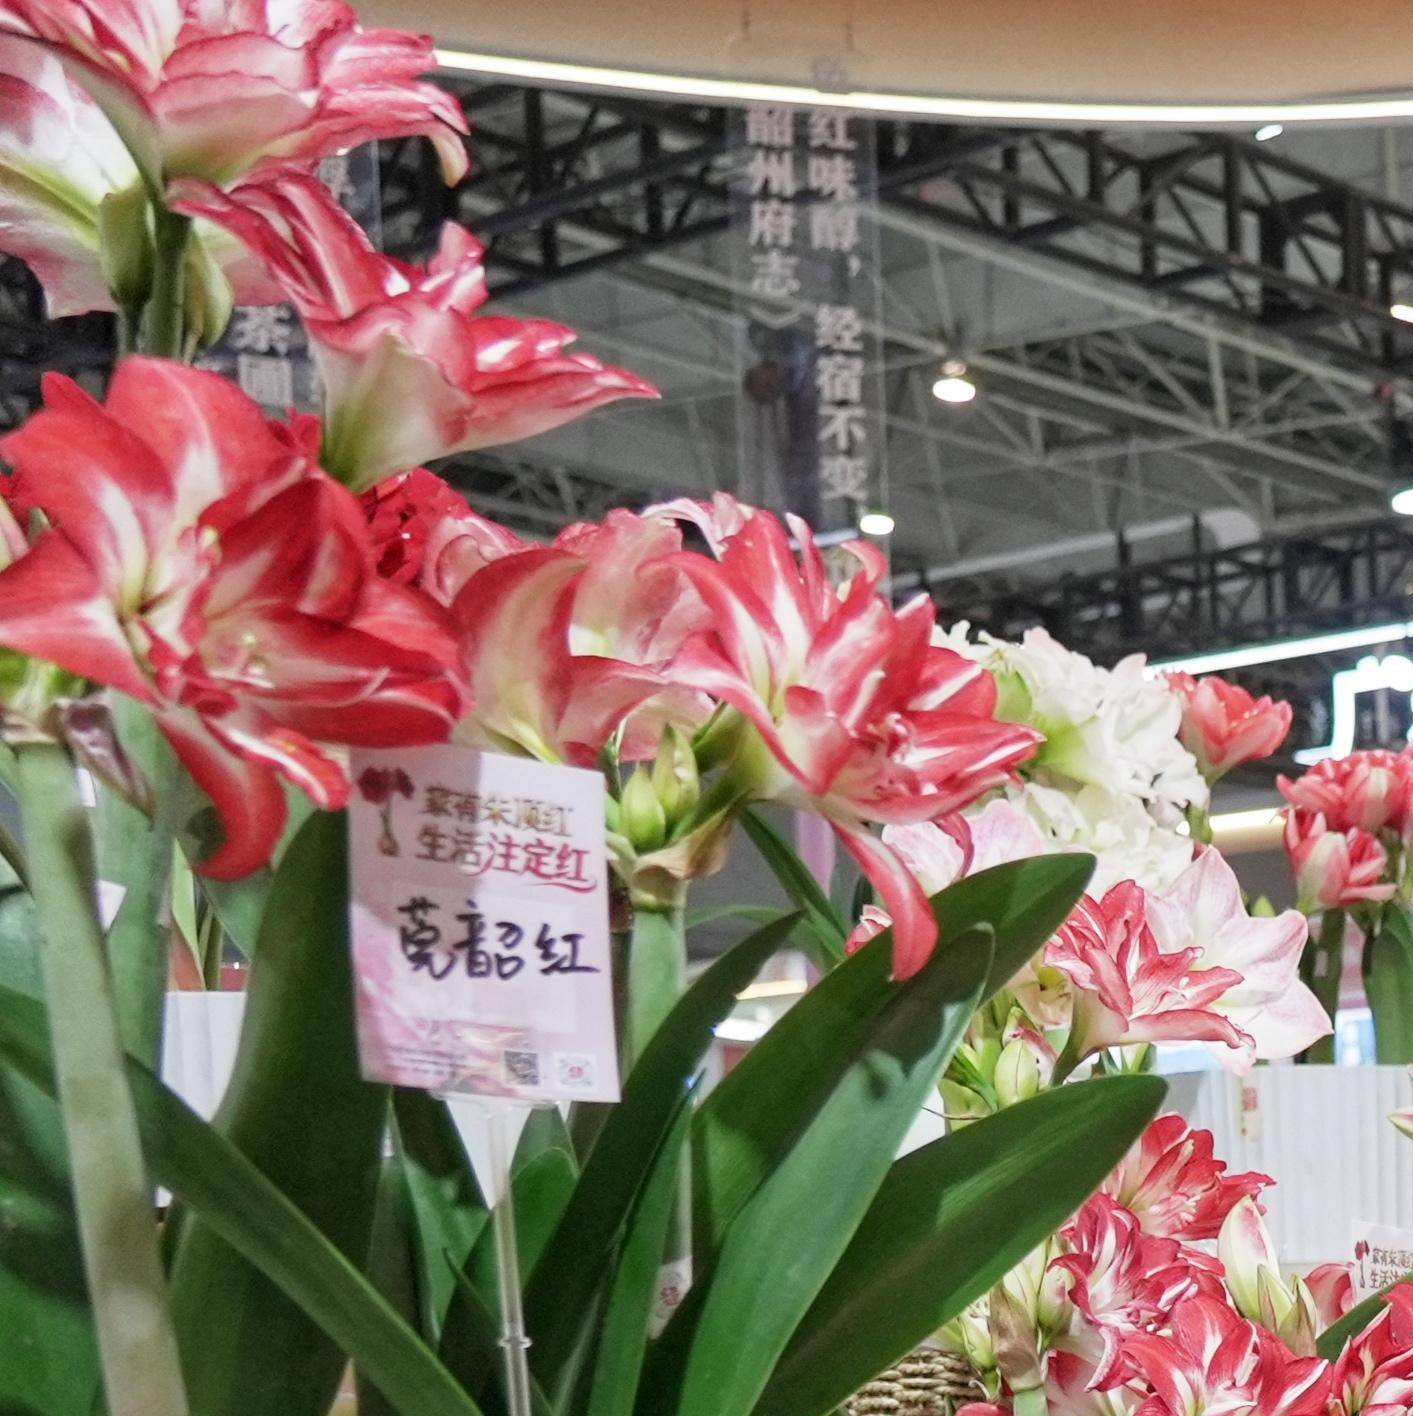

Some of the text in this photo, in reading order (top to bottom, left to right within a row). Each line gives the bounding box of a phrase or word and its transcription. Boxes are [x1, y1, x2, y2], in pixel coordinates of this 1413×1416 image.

[422, 783, 575, 838] 家有朱顶红
[413, 818, 598, 893] 生活注定红
[397, 896, 601, 982] 莞韶红
